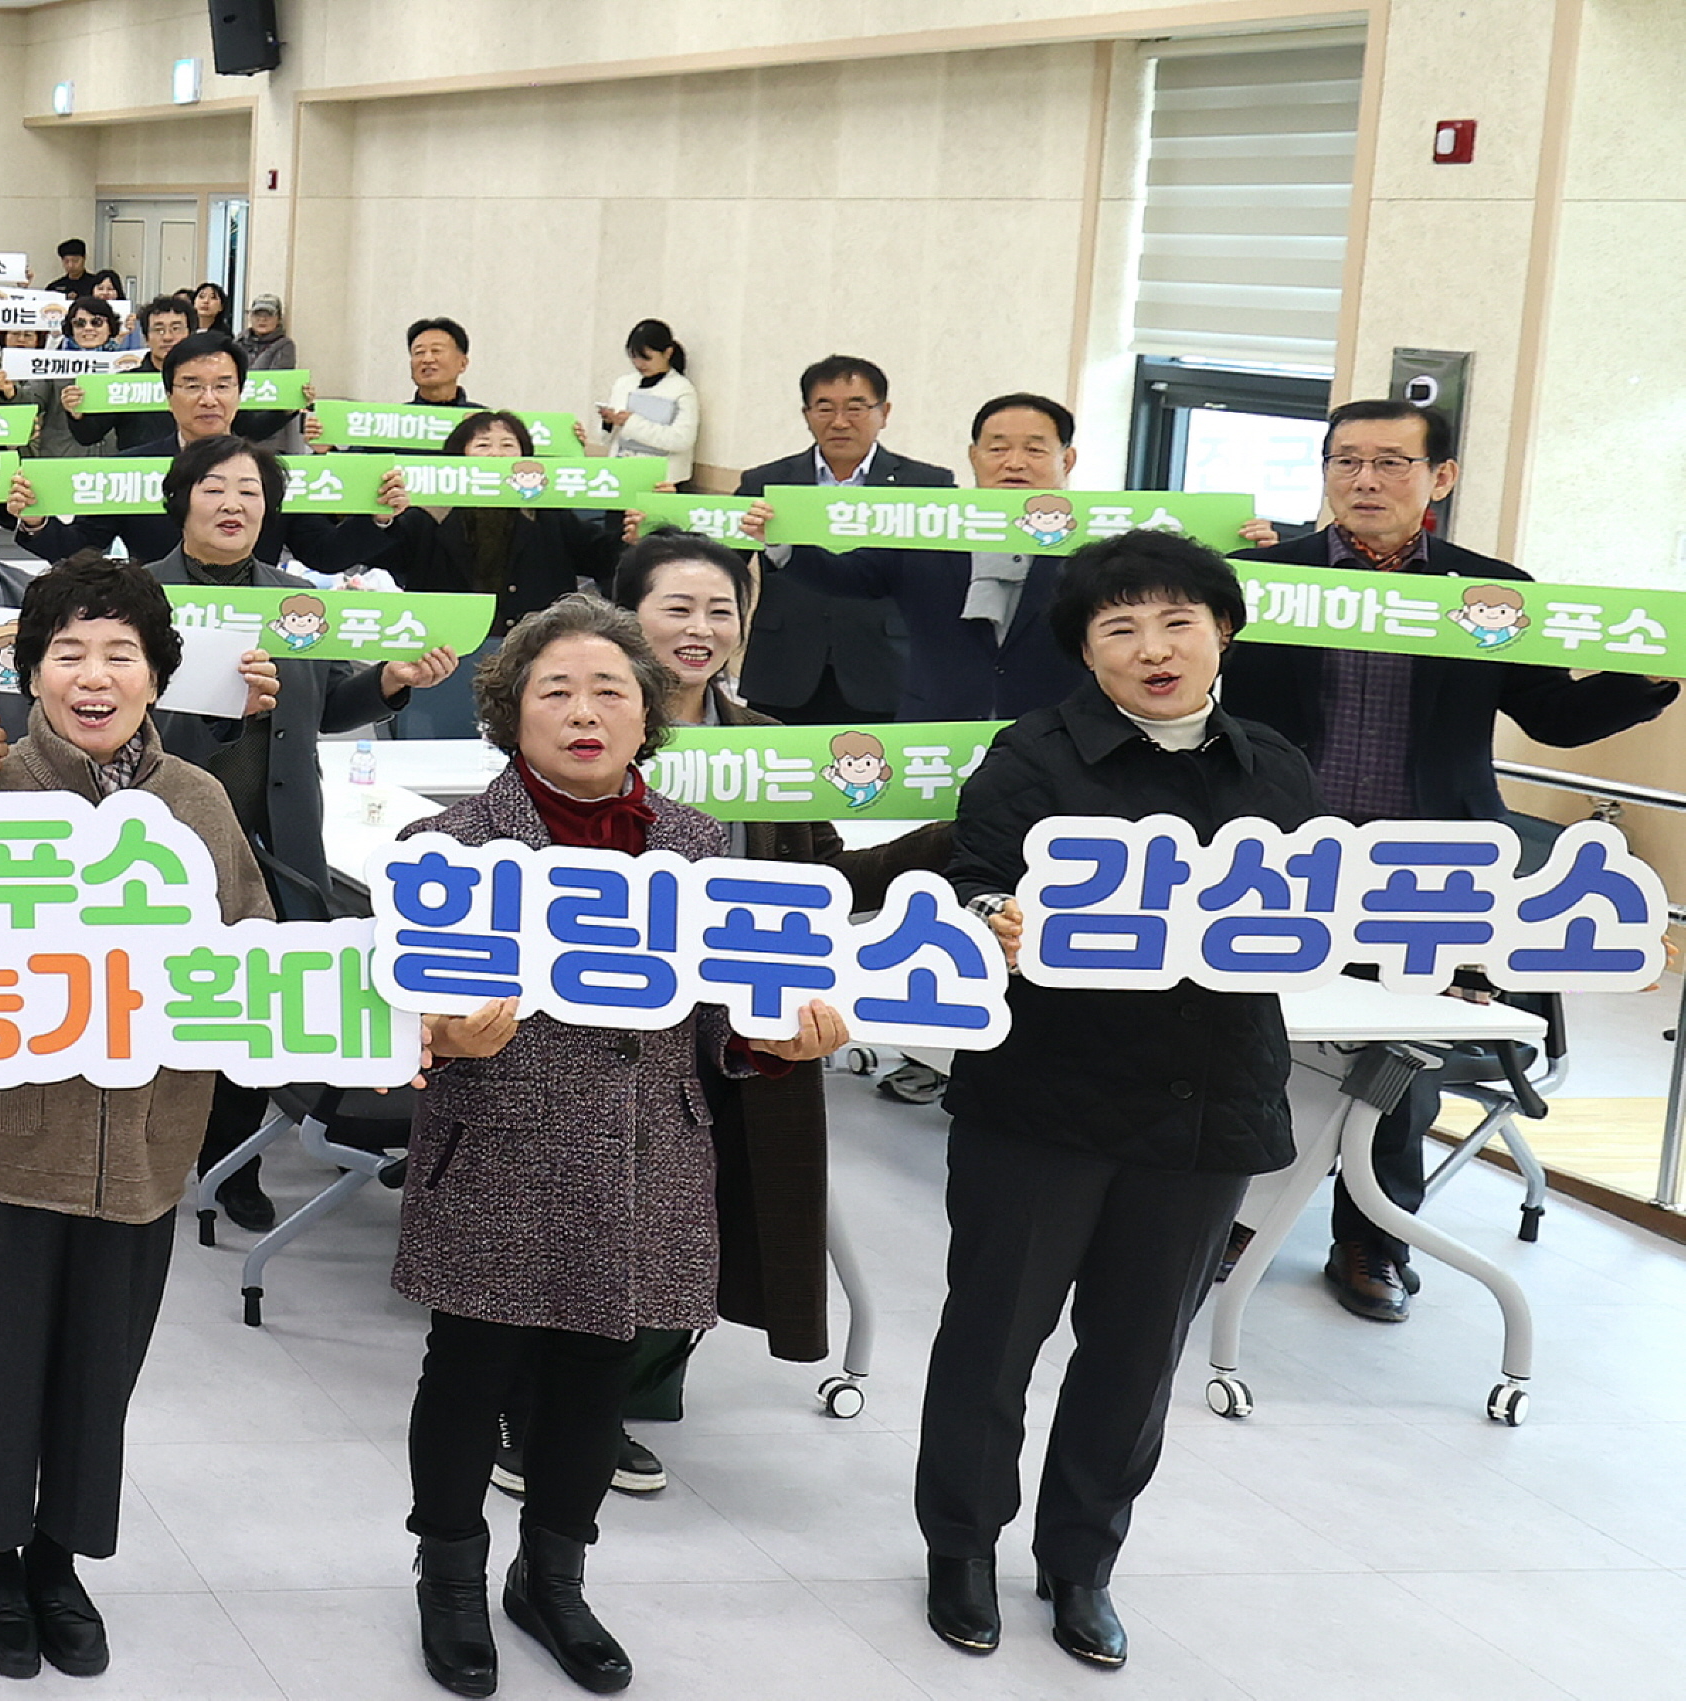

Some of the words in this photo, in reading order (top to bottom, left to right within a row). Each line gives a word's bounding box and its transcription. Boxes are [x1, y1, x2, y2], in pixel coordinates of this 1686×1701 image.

[31, 356, 110, 374] 함께하는
[347, 411, 453, 441] 함께하는
[397, 463, 501, 497] 께하는
[555, 467, 620, 498] 푸소
[825, 499, 1007, 540] 함께하는
[336, 608, 427, 649] 푸소
[1541, 601, 1668, 655] 푸소
[640, 748, 816, 804] 께하는
[1038, 834, 1649, 976] 감성푸소
[385, 851, 990, 1030] 힐링푸소
[163, 945, 393, 1059] 확대
